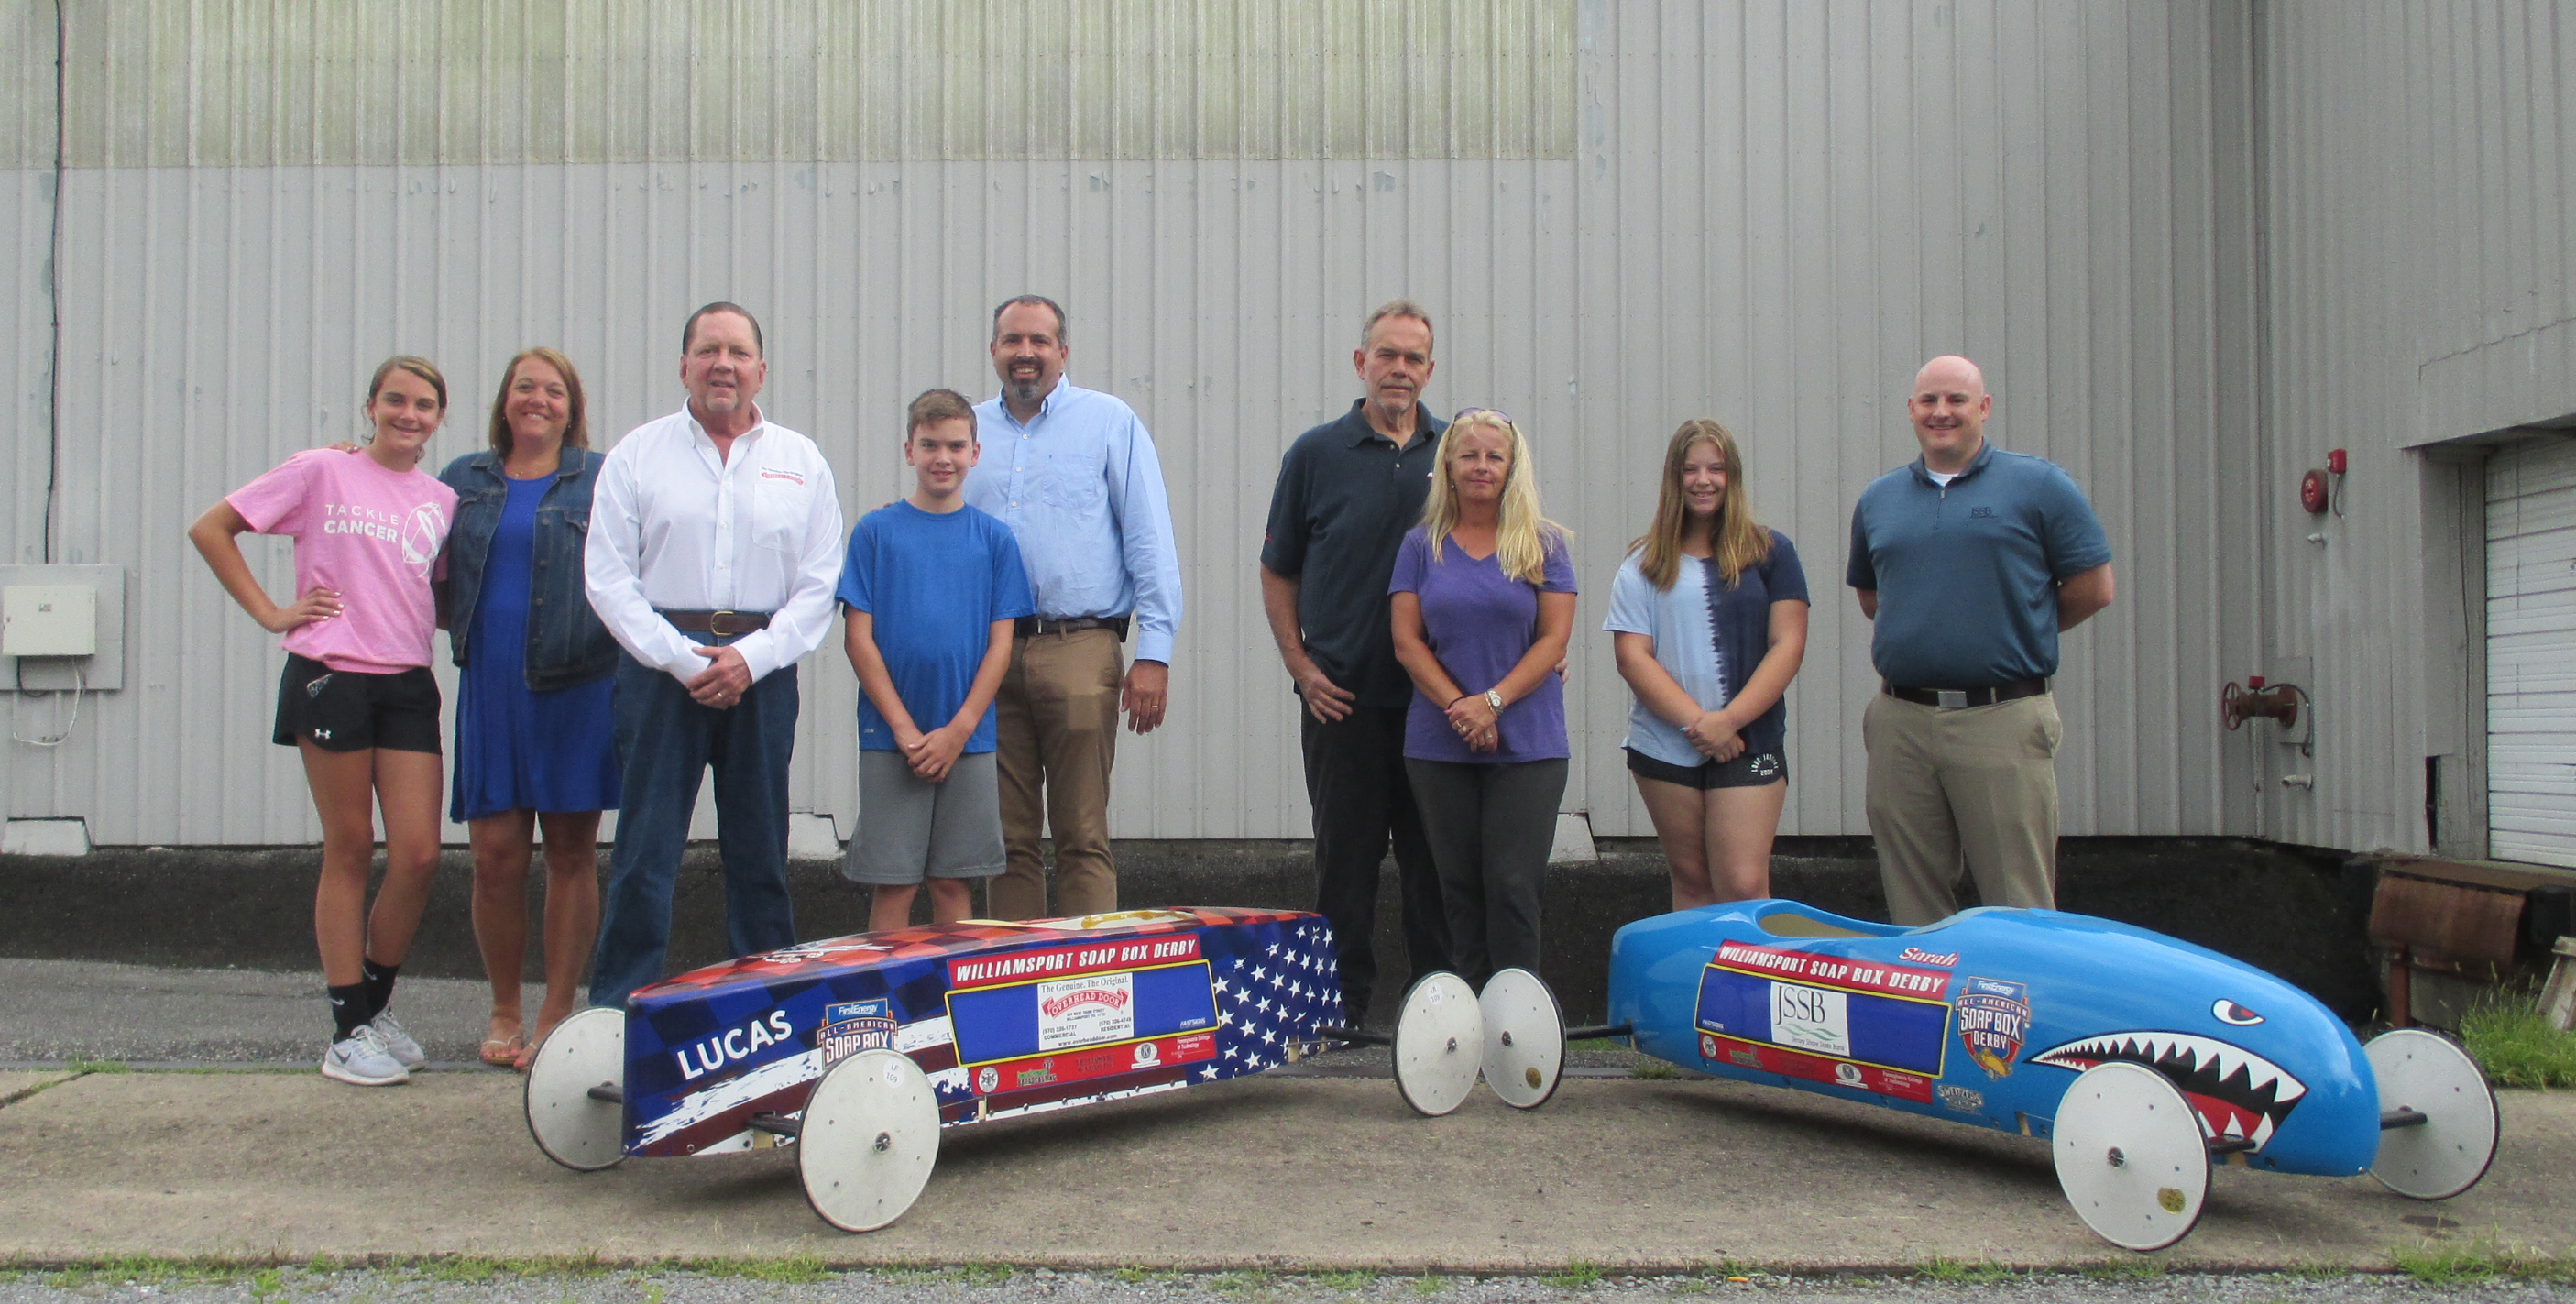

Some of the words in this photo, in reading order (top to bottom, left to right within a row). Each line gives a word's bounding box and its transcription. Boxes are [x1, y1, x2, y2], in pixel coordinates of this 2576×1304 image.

[325, 504, 399, 525] TACKLE
[323, 520, 398, 542] CANCER
[956, 952, 1073, 982] WILLIAMSPORT
[1079, 948, 1116, 967] SOAP
[1121, 944, 1147, 962] BOX
[1153, 939, 1196, 959] DERBY
[1898, 947, 1959, 968] Sarah
[1719, 945, 1807, 974] WILLIAMSPORT
[1810, 959, 1847, 980] SOAP
[1852, 968, 1883, 985] BOX
[1888, 973, 1945, 993] DERBY
[1041, 985, 1055, 993] The
[1087, 979, 1100, 988] The
[838, 1003, 879, 1016] FirstEnergy
[1051, 992, 1096, 1014] OVERHEAD
[1098, 992, 1120, 1007] DOOR
[1776, 985, 1825, 1025] JSSB
[820, 1020, 895, 1040] ALL-AMERICAN
[1960, 1006, 1993, 1032] SOAP
[1994, 1013, 2021, 1040] BOX
[677, 1010, 793, 1080] LUCAS
[826, 1034, 861, 1064] SOAP
[1973, 1030, 2009, 1050] DERBY
[887, 1072, 898, 1082] 109
